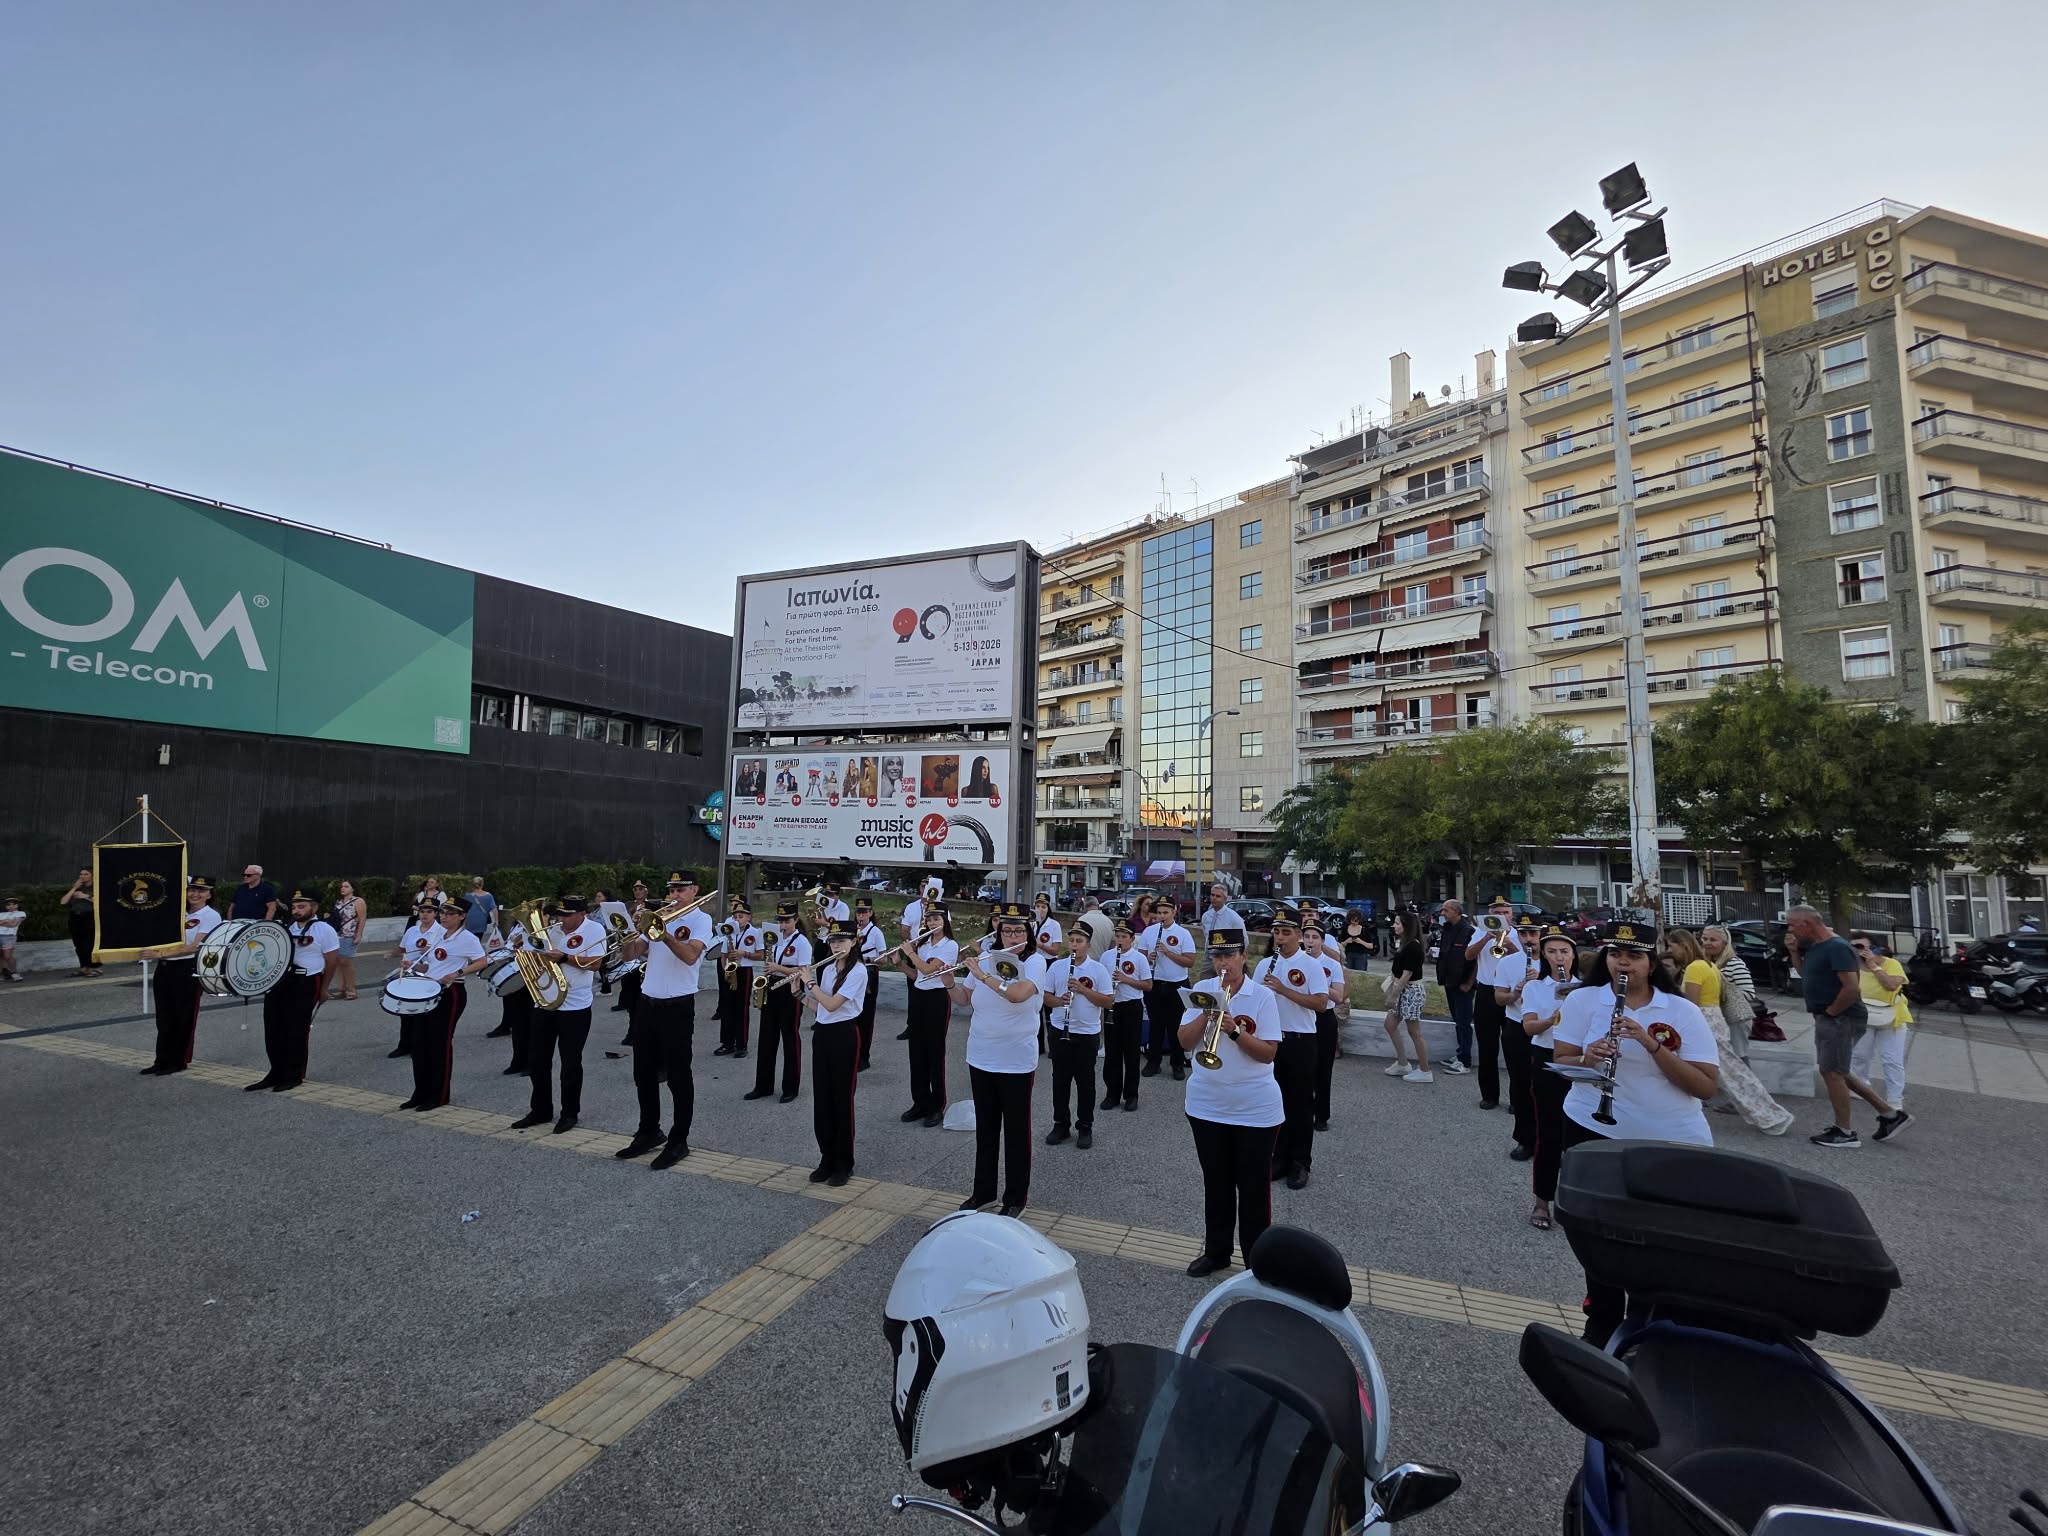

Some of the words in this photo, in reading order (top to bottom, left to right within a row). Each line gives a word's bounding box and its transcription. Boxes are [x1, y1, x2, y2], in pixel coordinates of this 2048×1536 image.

[1762, 241, 1856, 288] HOTEL
[787, 579, 880, 608] Ιαπωνία.
[786, 612, 797, 621] Για
[785, 627, 820, 637] Experience
[785, 637, 796, 645] For
[796, 636, 807, 644] the
[808, 635, 821, 643] first
[980, 638, 1001, 650] 2026
[784, 646, 792, 654] At
[804, 644, 843, 653] Thessaloniki
[783, 653, 823, 663] International
[971, 657, 1001, 667] JAPAN
[41, 644, 214, 690] Telecom
[860, 814, 914, 833] music
[922, 818, 947, 840] live
[855, 833, 914, 848] events
[235, 927, 280, 951] ΦΙΛΑΡΜΟΝΙΚΗ
